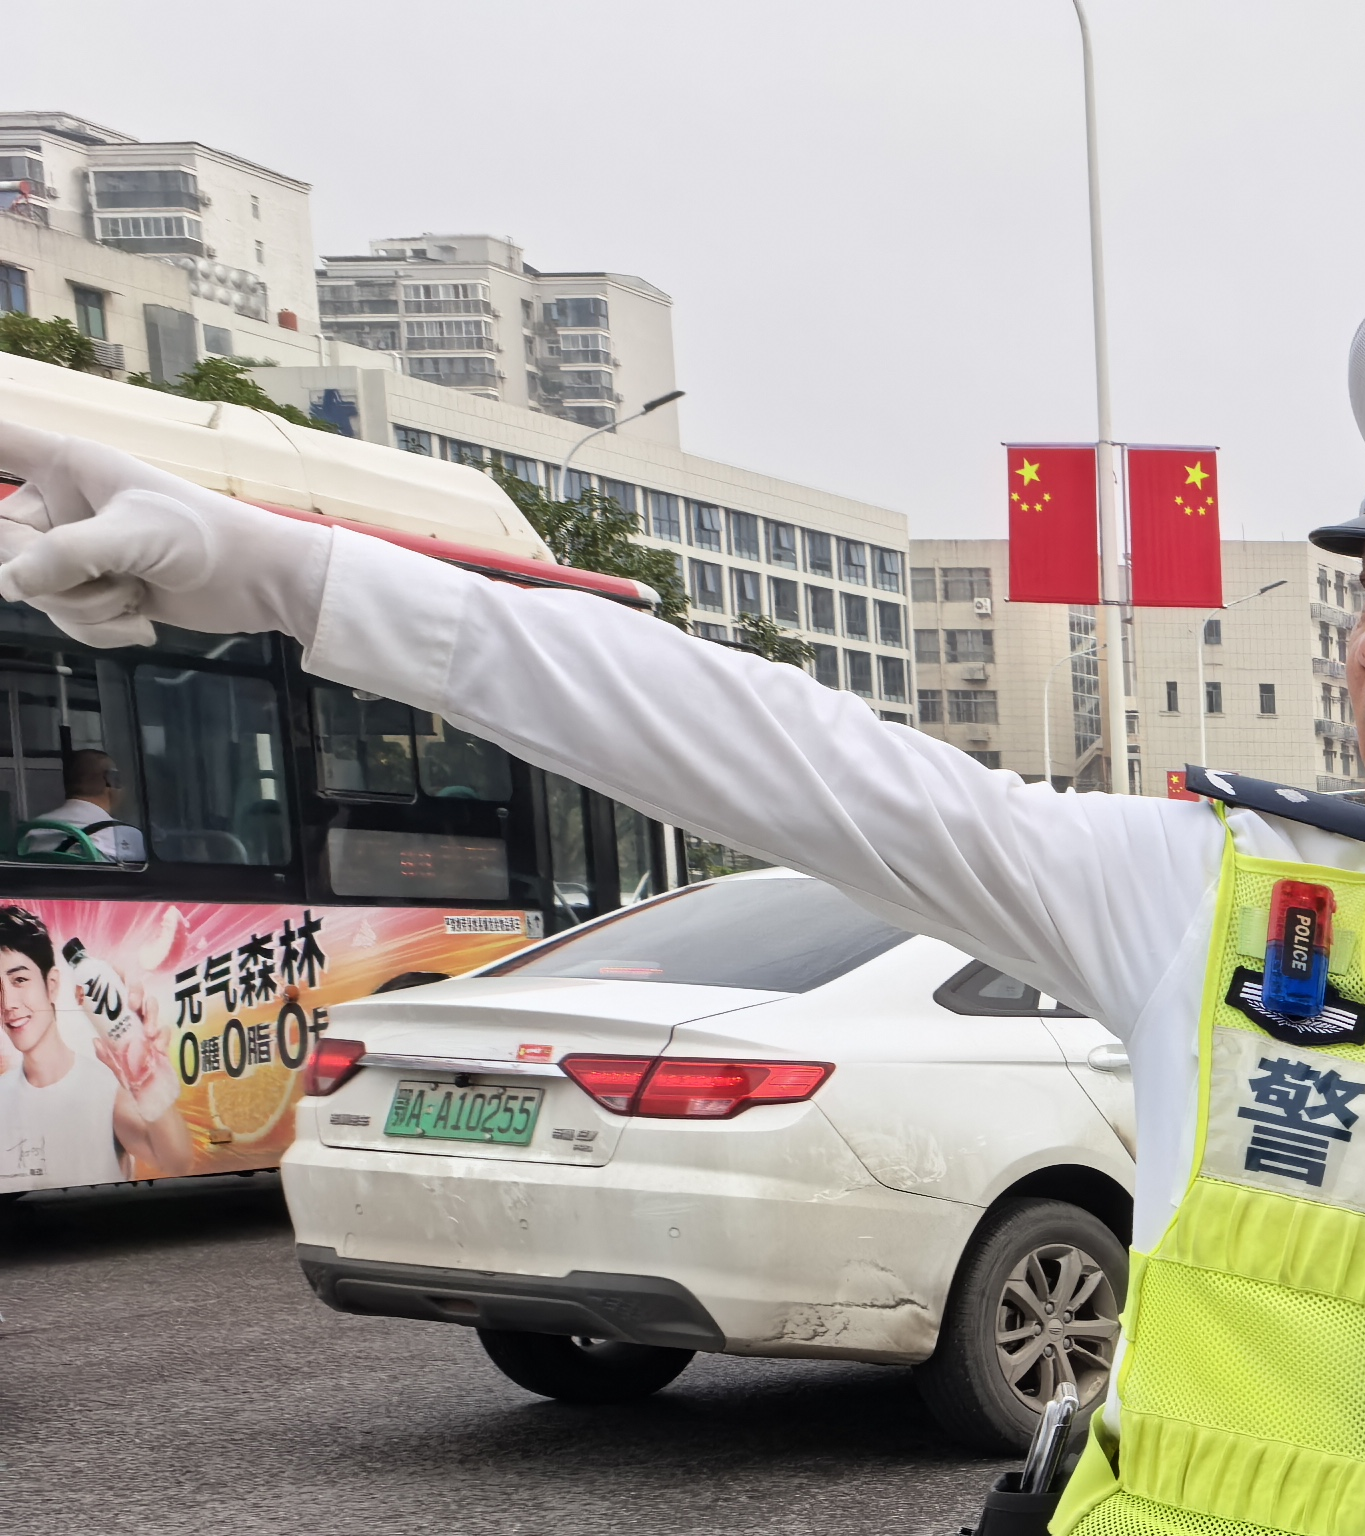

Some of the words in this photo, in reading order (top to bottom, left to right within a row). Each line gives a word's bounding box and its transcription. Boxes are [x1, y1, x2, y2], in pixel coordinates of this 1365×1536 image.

[174, 909, 325, 1029] 元气森林
[1291, 914, 1312, 972] POLICE
